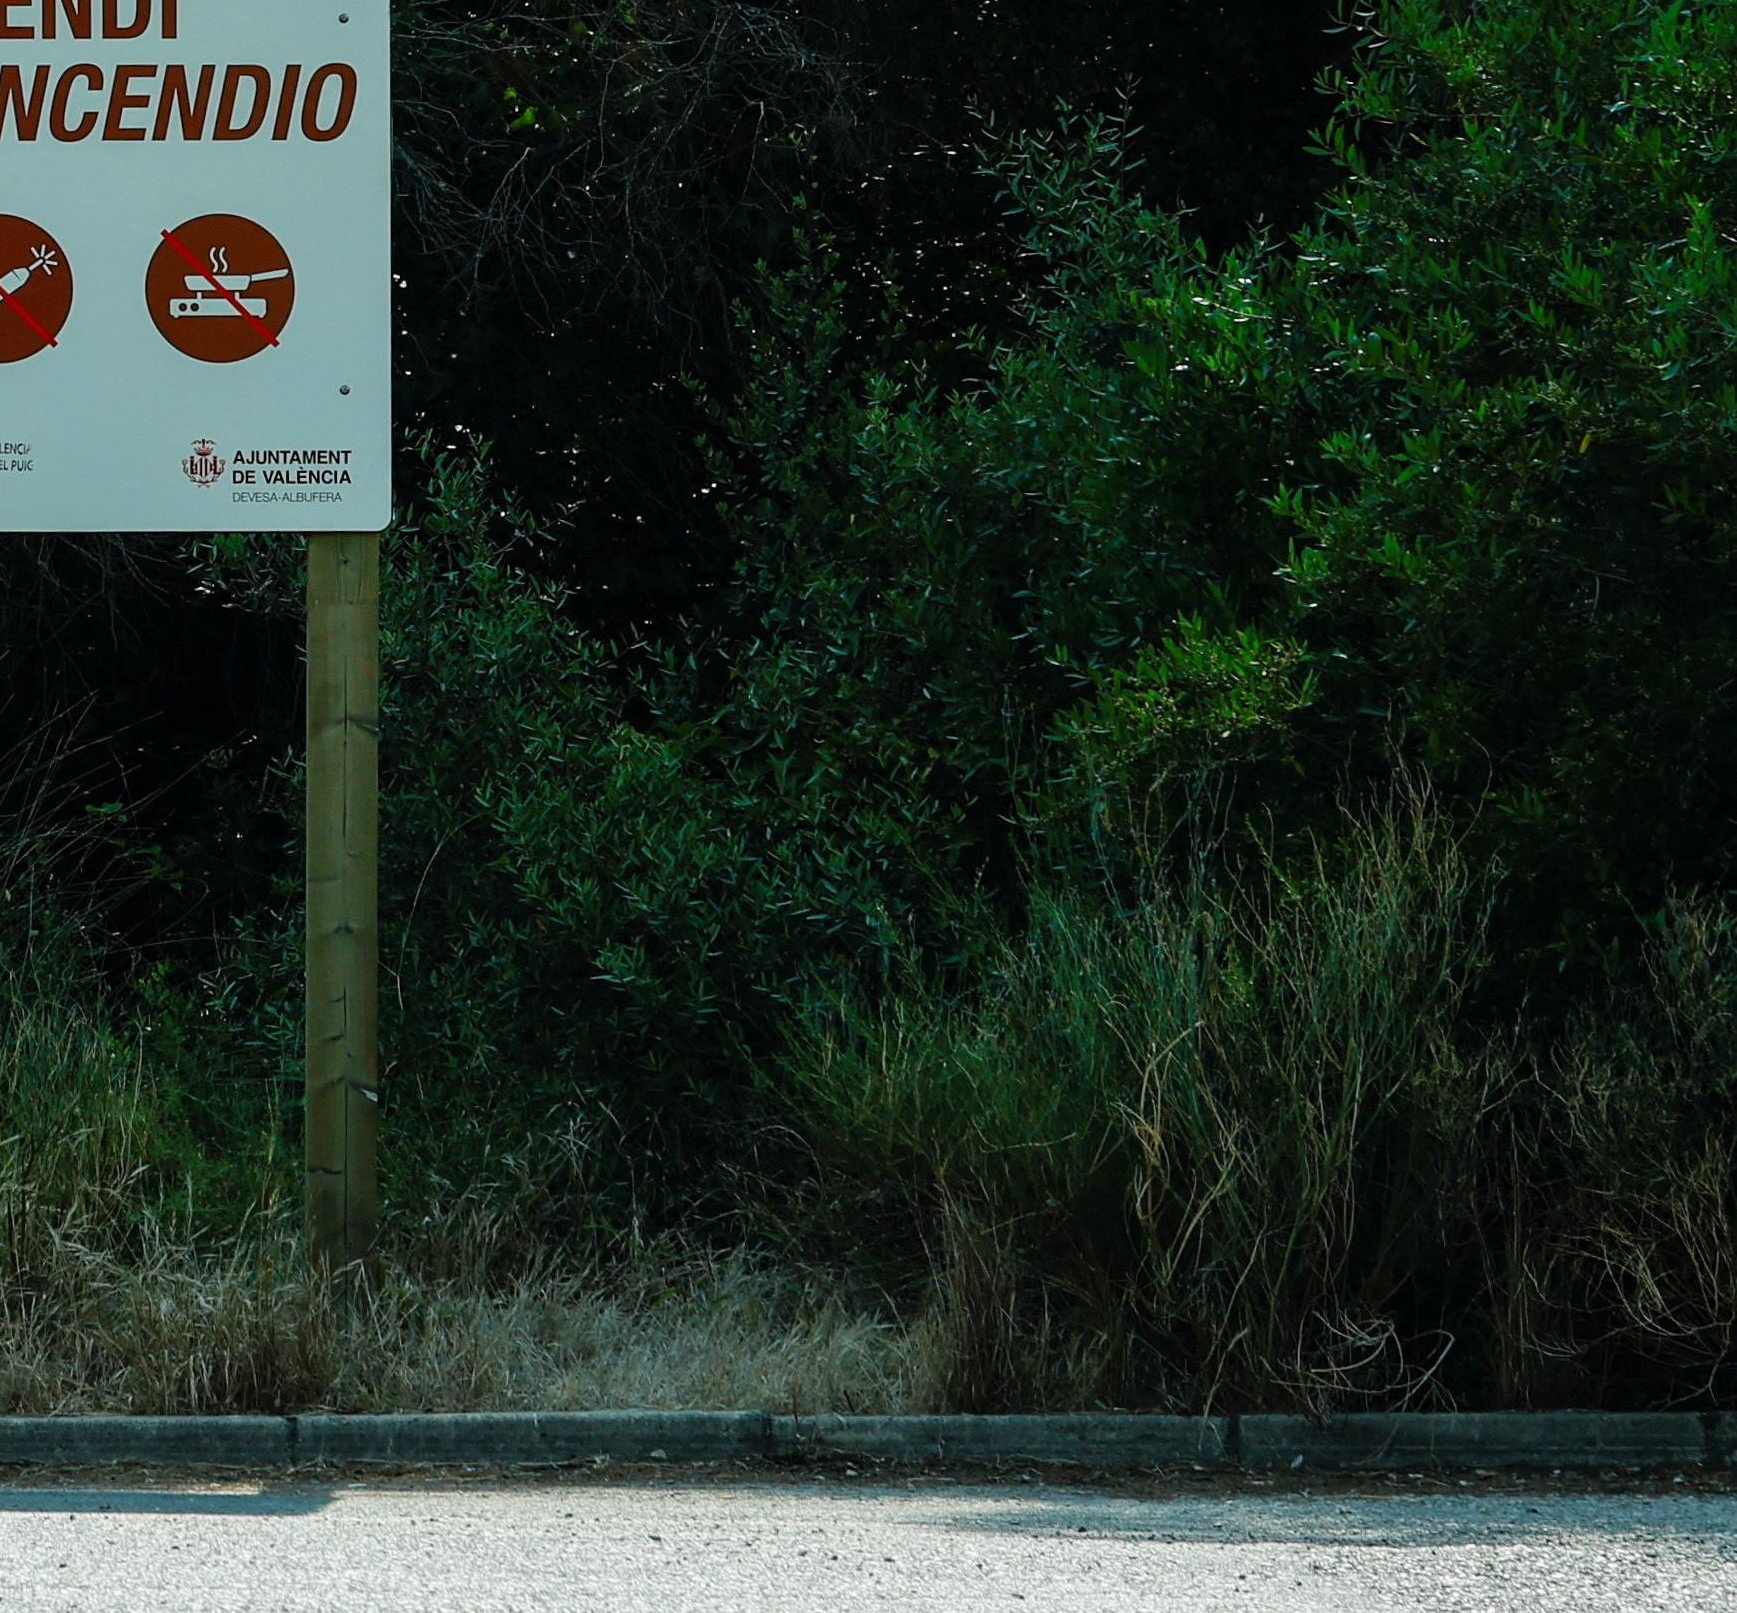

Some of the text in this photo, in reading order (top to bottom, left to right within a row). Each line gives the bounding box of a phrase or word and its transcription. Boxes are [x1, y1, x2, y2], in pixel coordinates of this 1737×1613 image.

[233, 450, 353, 465] AJUNTAMENT
[232, 467, 353, 485] DE VALÈNCIA
[232, 492, 343, 503] DEVESA-ALBUFERA
